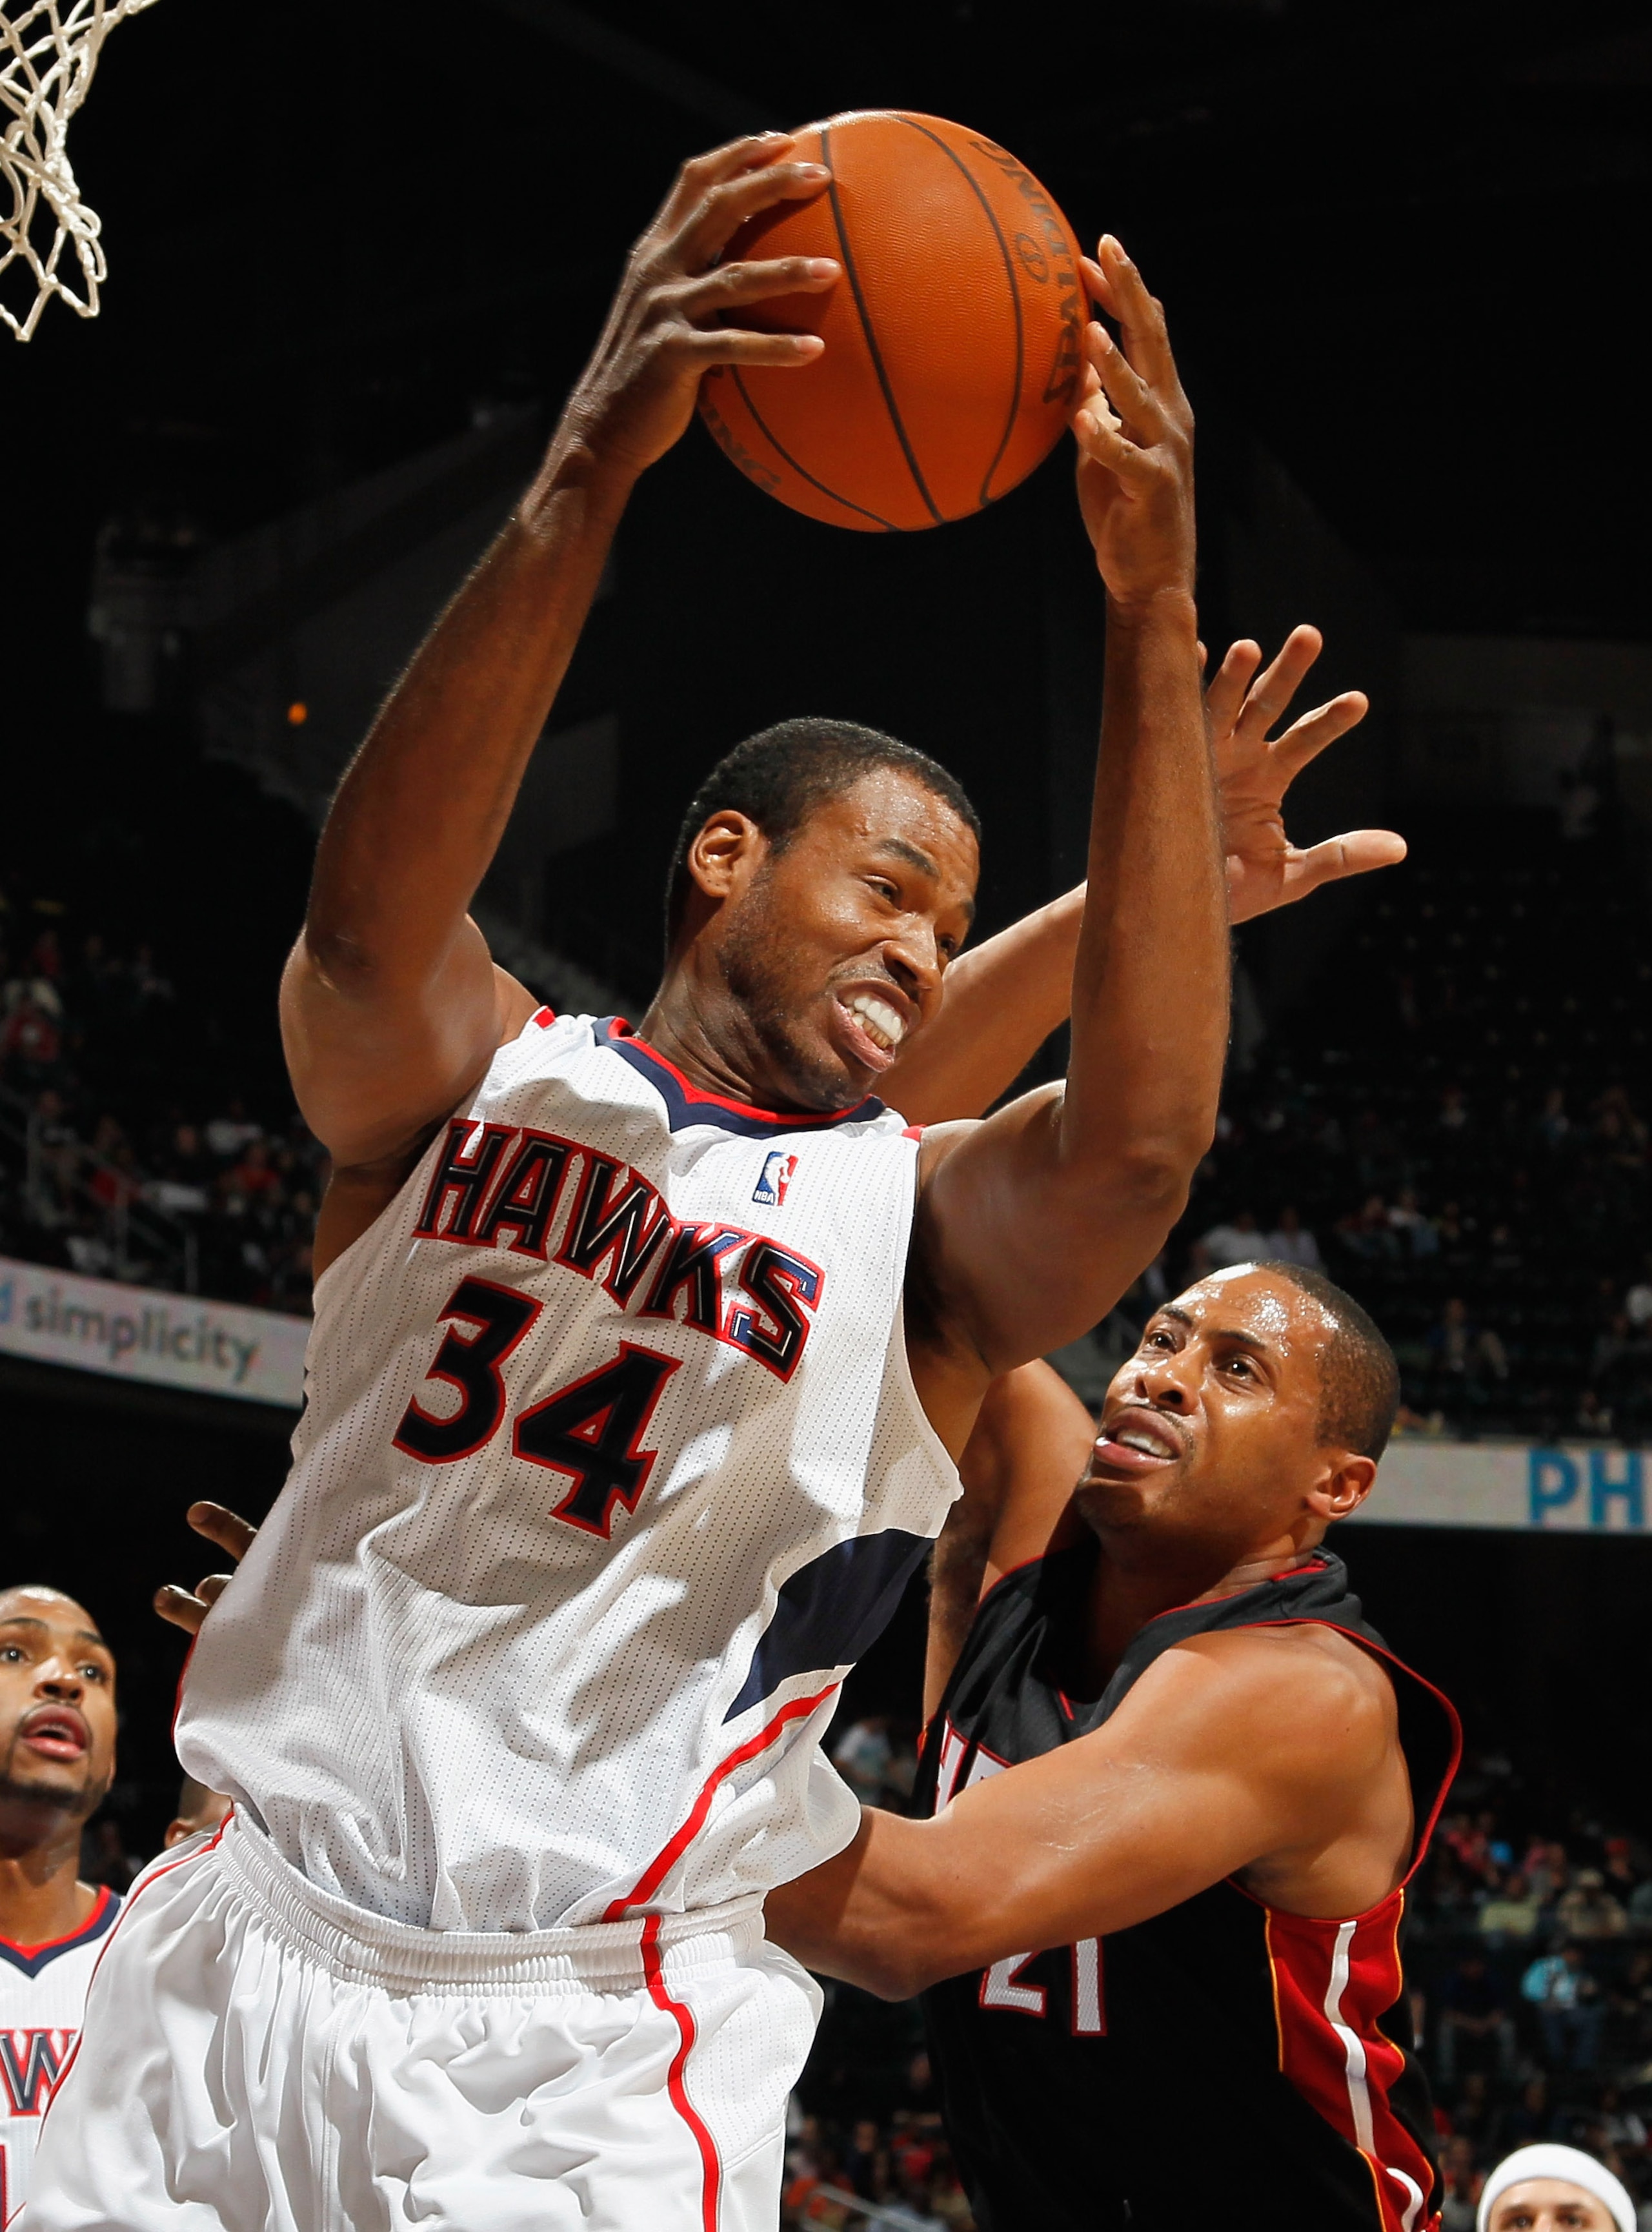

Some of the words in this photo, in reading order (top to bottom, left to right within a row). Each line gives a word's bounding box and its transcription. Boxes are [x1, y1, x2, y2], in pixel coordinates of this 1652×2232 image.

[752, 1189, 775, 1204] NBA
[412, 1119, 825, 1384] HAWKS
[26, 1286, 257, 1383] simplicity
[391, 1275, 683, 1540] 34
[1529, 1446, 1646, 1526] PH
